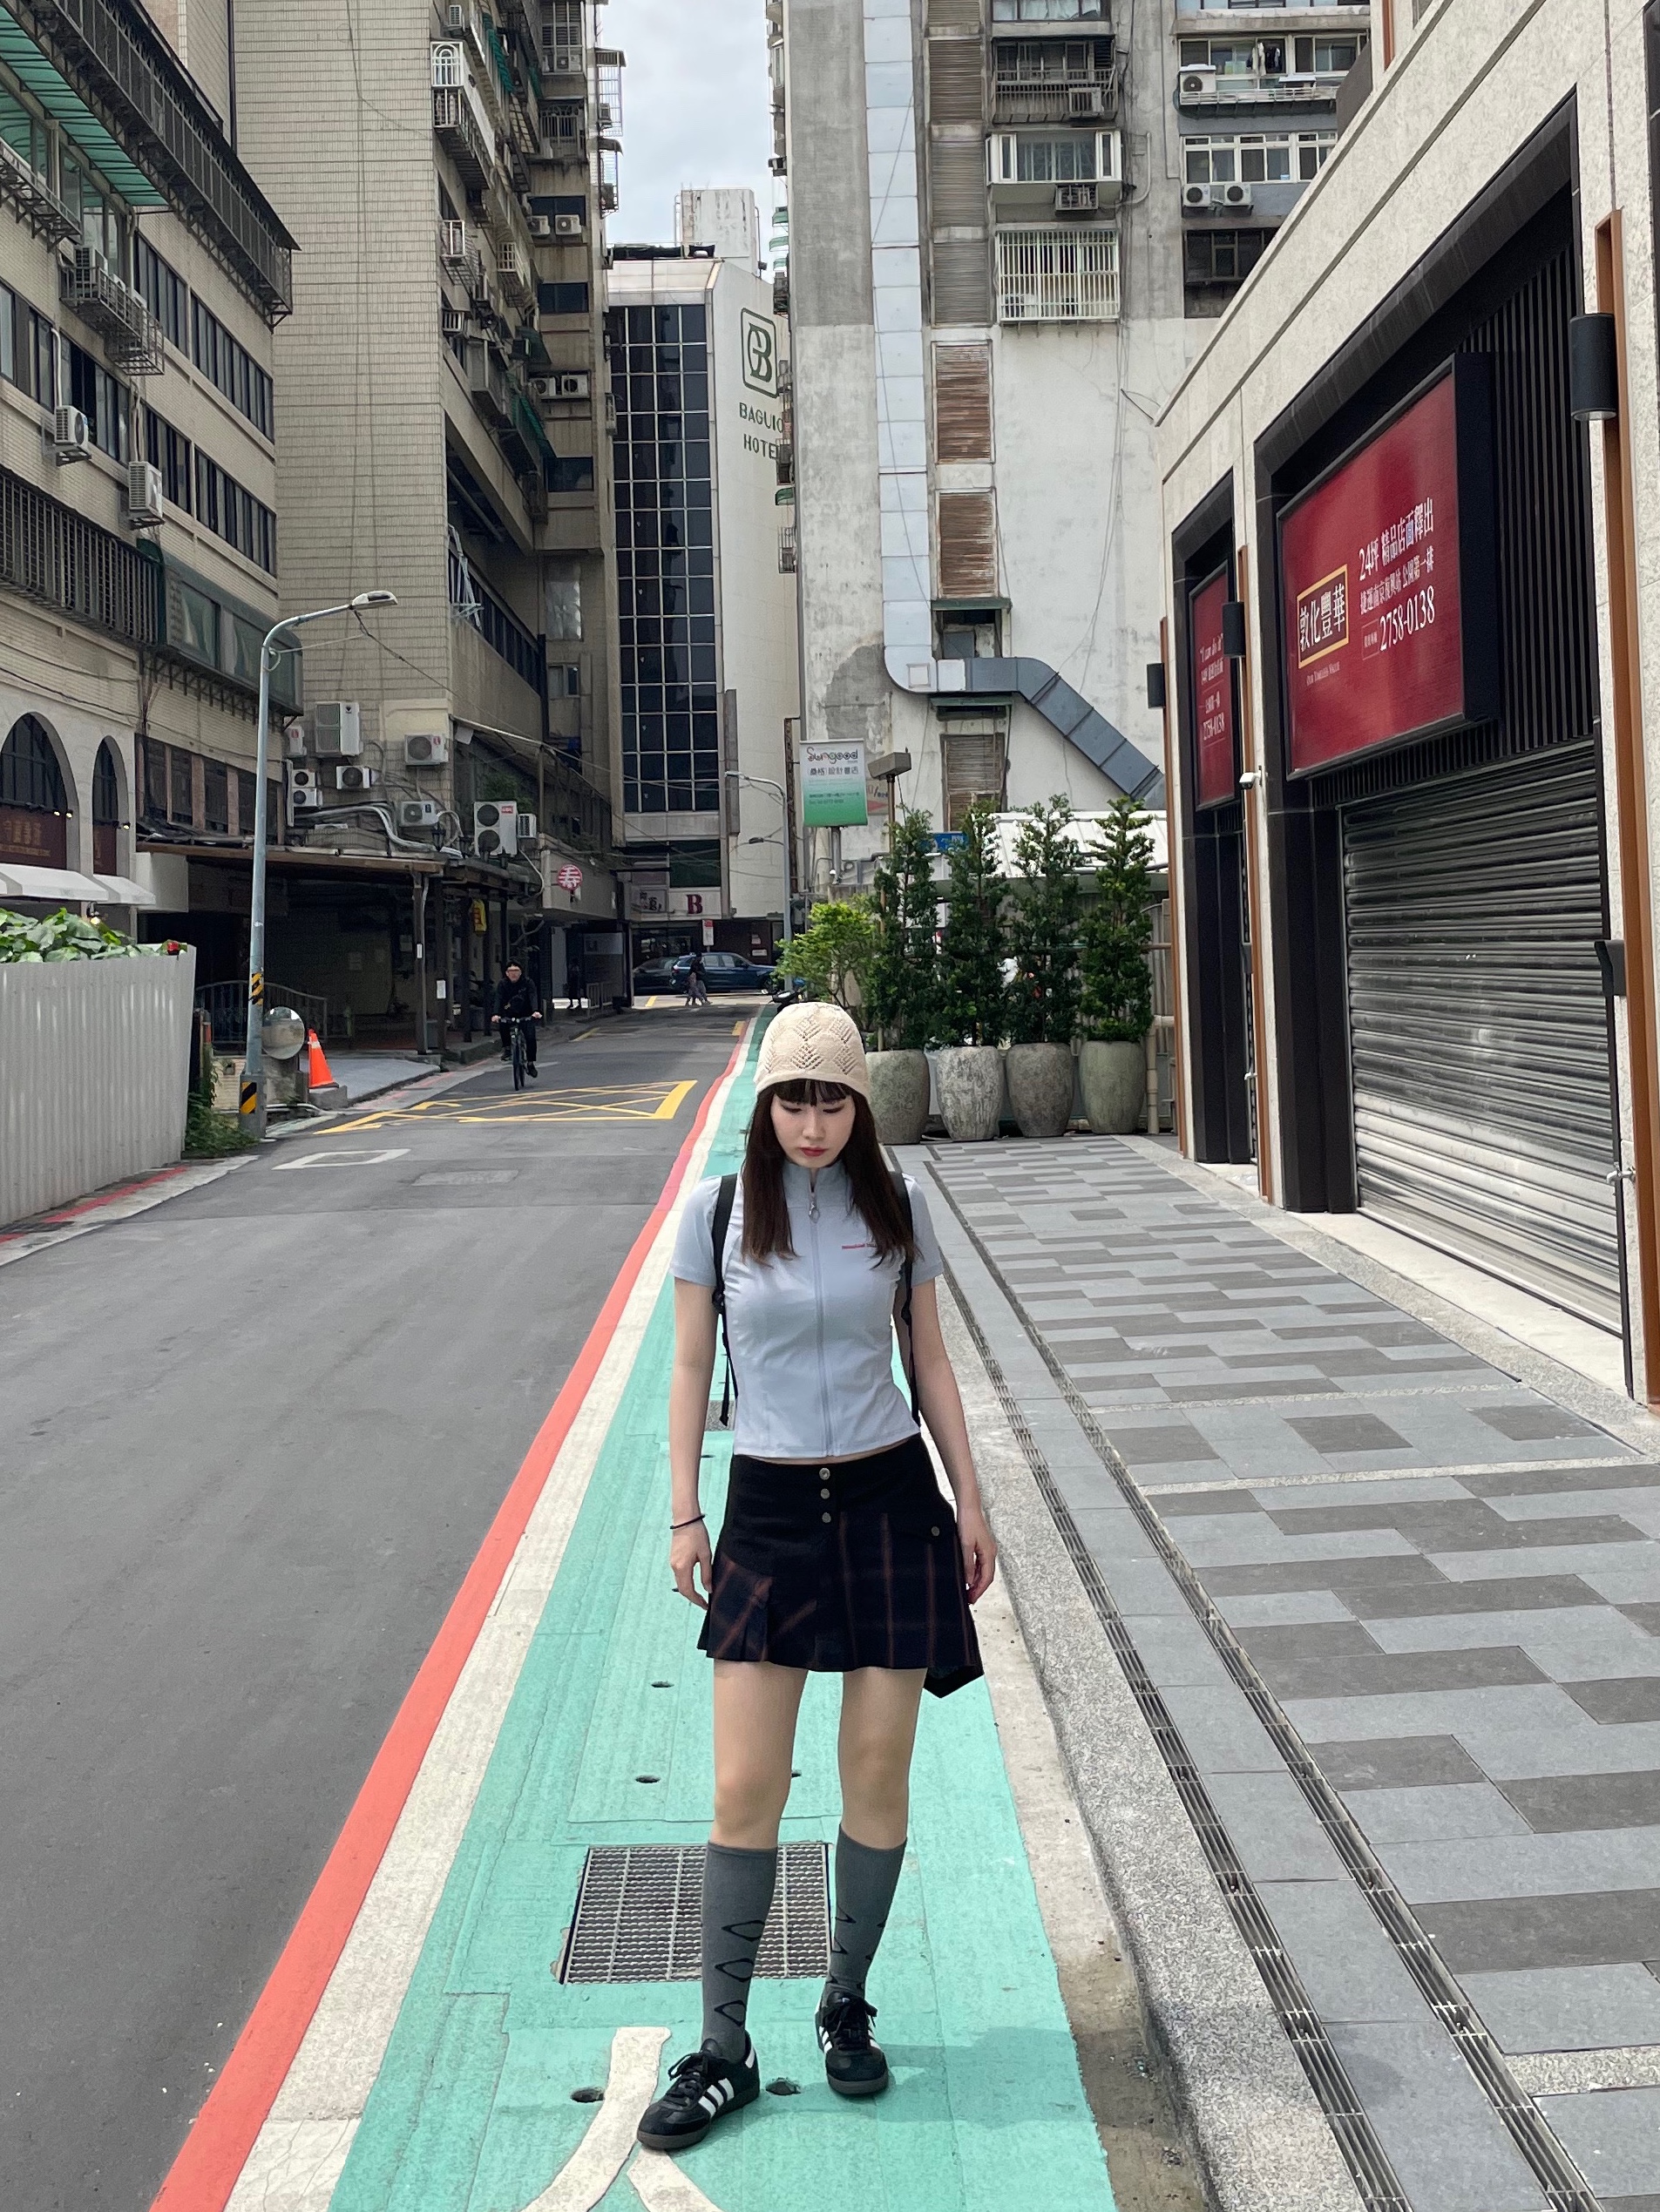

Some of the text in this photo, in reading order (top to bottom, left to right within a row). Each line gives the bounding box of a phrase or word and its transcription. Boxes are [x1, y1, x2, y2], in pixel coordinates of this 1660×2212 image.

[1381, 497, 1434, 566] 精品店面釋出
[1298, 583, 1345, 653] 敦化豐華
[1379, 585, 1435, 652] 2758-0138
[686, 894, 703, 914] B
